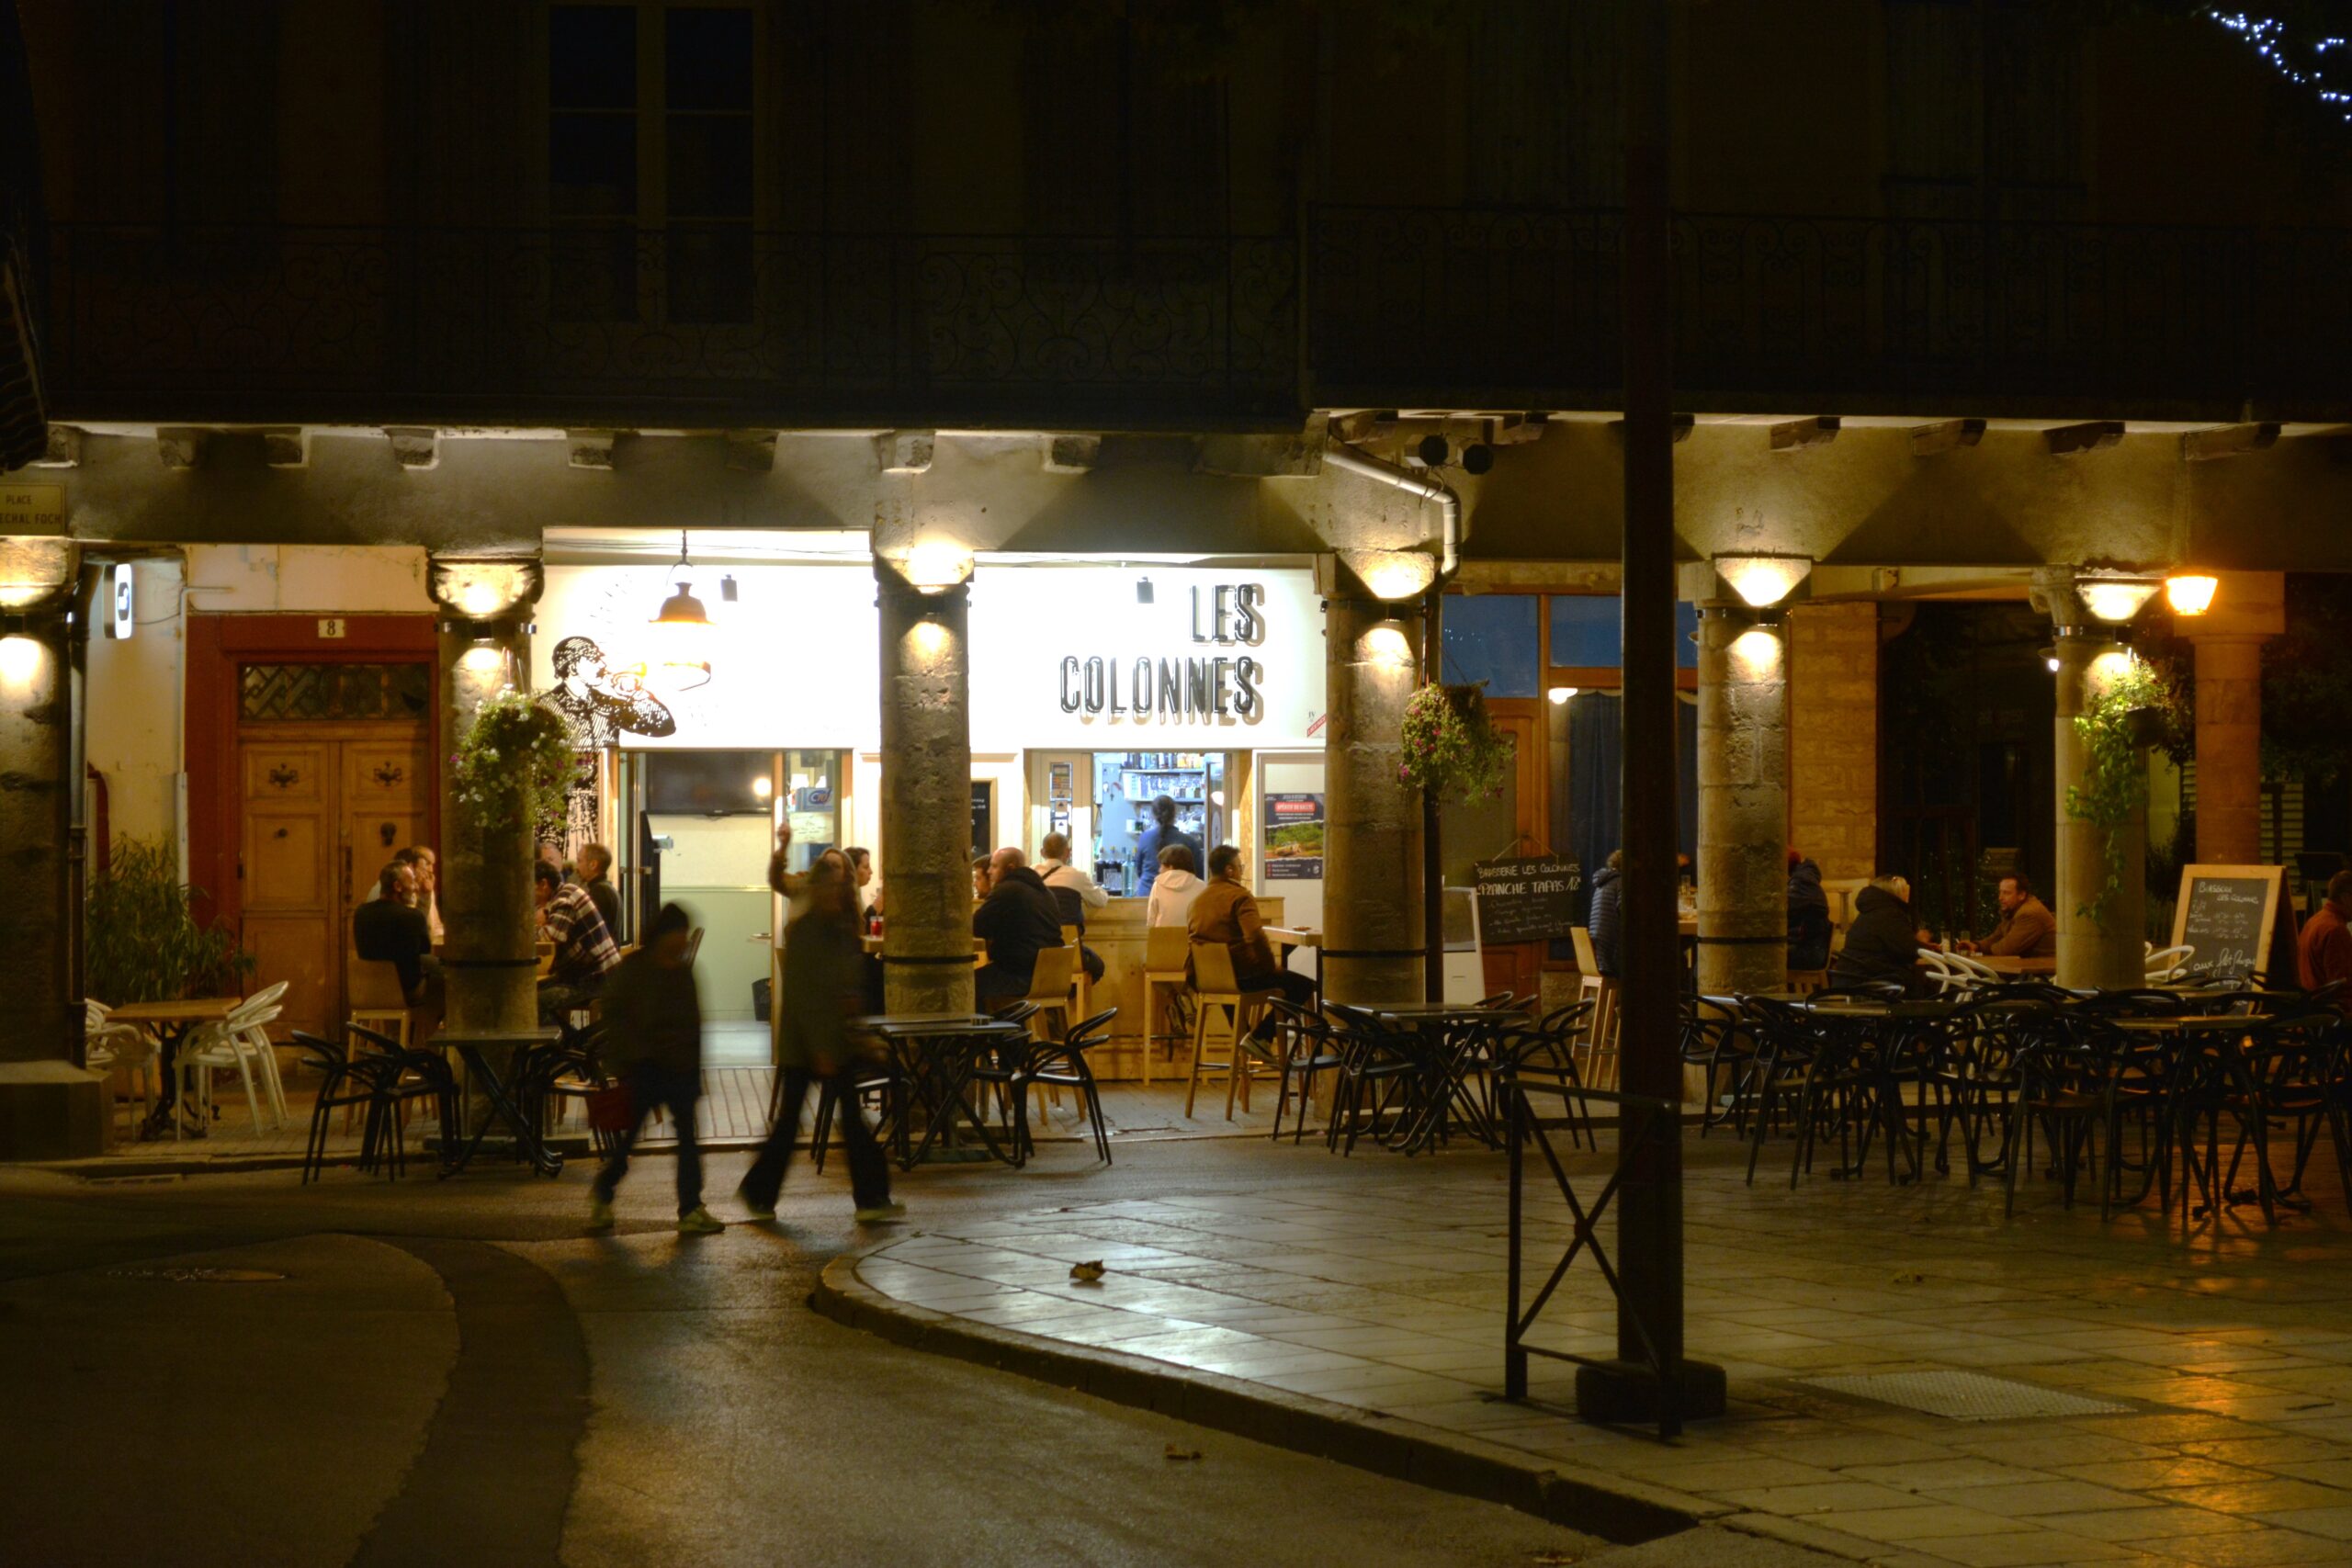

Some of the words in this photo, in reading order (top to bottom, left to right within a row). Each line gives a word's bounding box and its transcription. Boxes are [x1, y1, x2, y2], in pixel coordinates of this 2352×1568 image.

[6, 495, 32, 505] PLACE
[35, 513, 61, 525] FOCH
[1189, 583, 1255, 643] LES
[326, 619, 336, 637] 8
[1059, 655, 1256, 716] COLONNES
[1521, 864, 1537, 875] LES
[1532, 879, 1565, 894] TAPAS
